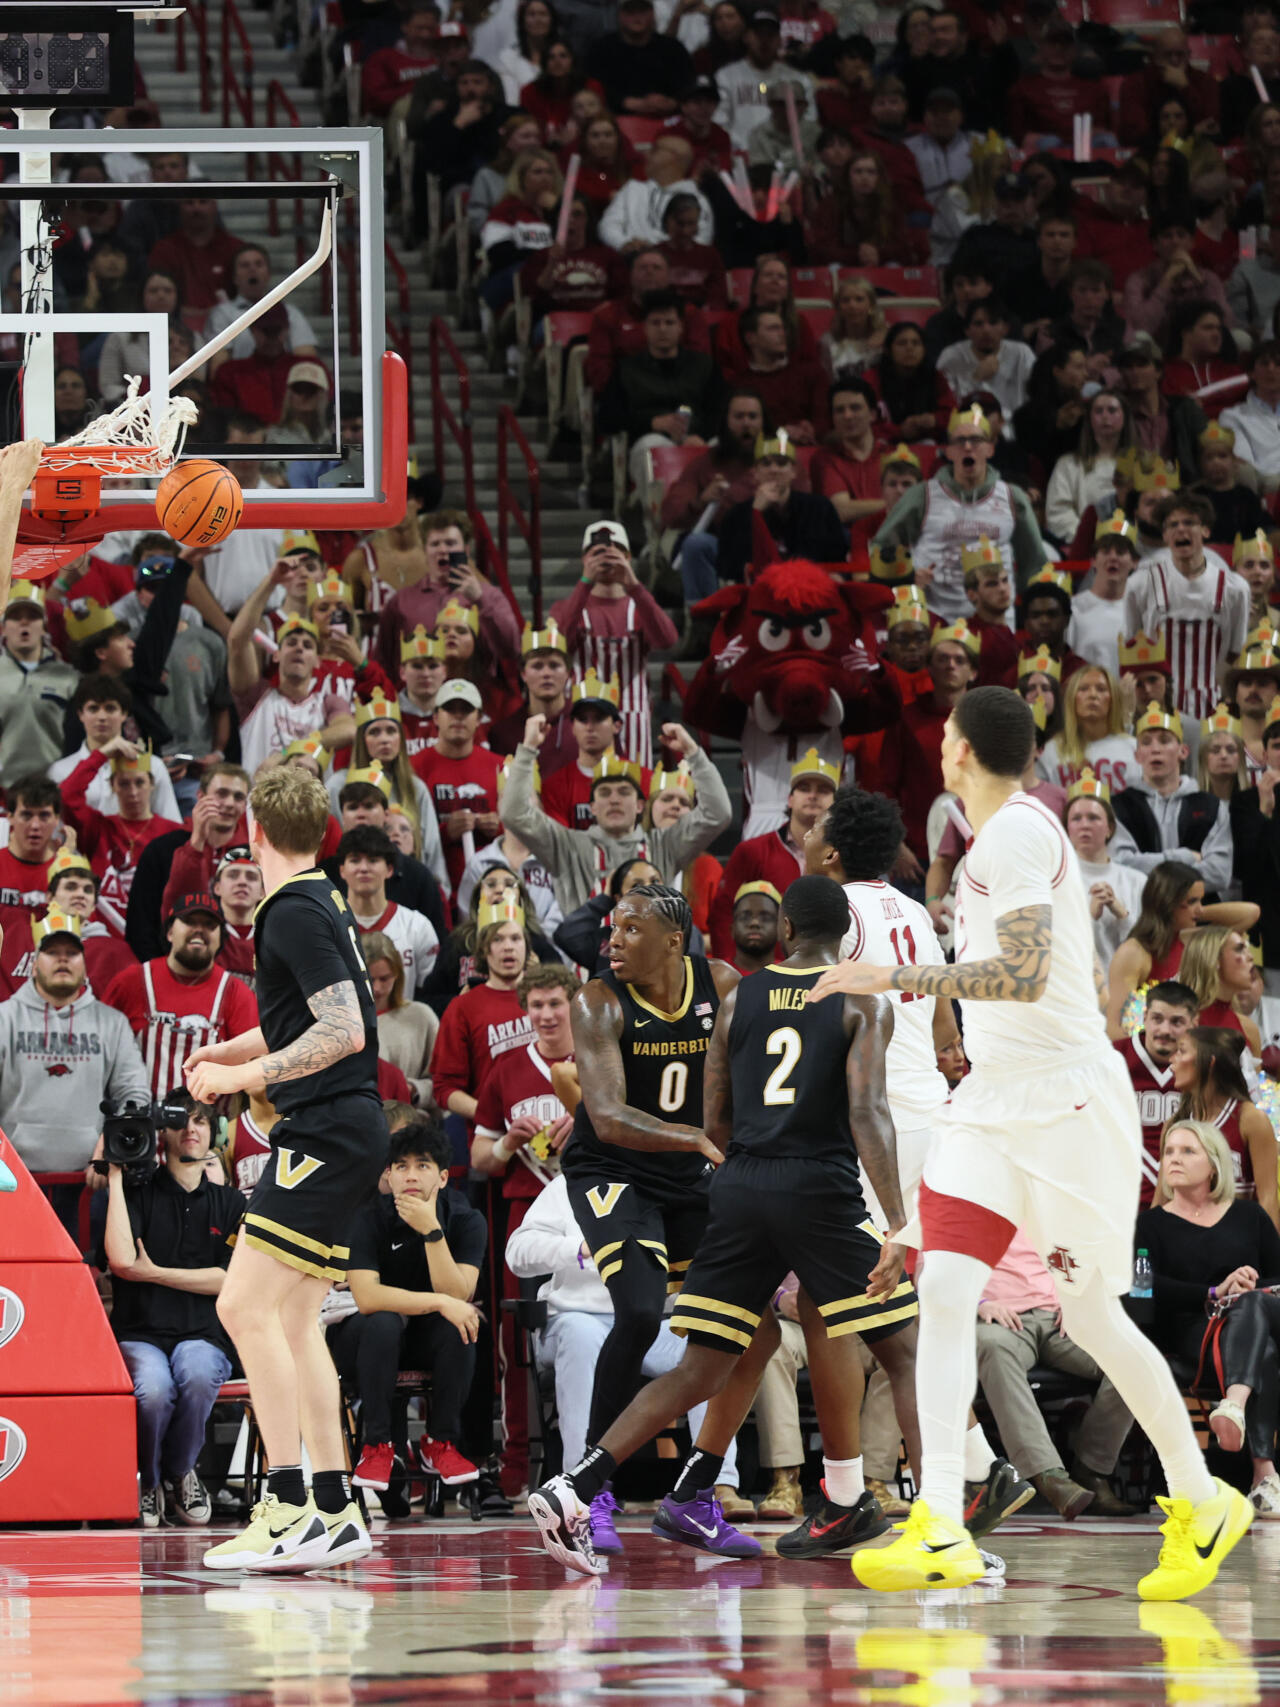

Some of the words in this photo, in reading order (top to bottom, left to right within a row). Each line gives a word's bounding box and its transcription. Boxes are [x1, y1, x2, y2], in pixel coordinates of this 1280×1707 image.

[196, 505, 228, 544] ELITE
[1057, 757, 1127, 795] HGS
[768, 987, 810, 1012] MILES
[16, 1031, 101, 1056] ARKANSAS
[487, 1015, 534, 1047] ARKAN
[763, 1026, 802, 1106] 2
[658, 1060, 689, 1112] 0
[275, 1146, 327, 1190] V
[585, 1182, 630, 1219] V
